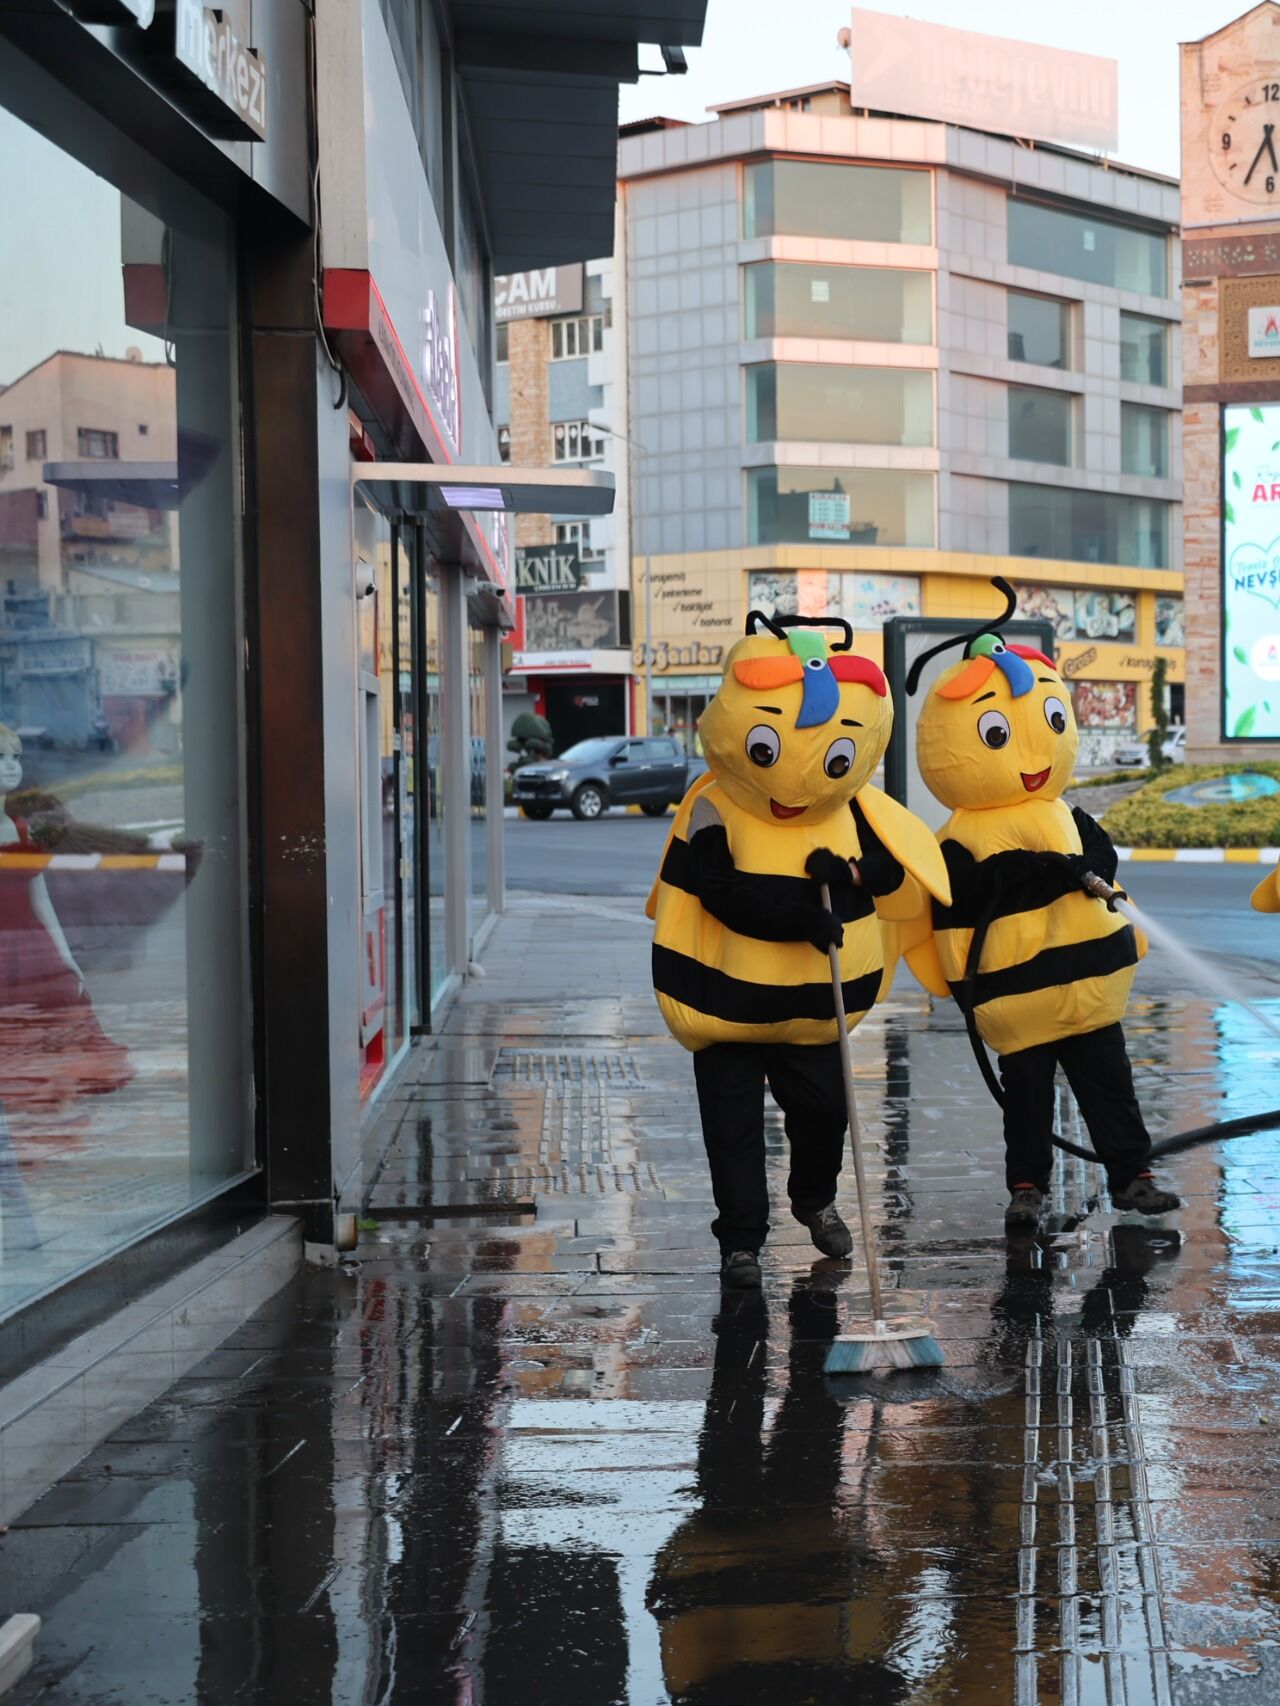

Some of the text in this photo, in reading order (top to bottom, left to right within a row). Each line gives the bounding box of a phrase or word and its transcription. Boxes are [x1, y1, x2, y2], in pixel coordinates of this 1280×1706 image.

[180, 3, 266, 129] merkezi
[1262, 84, 1280, 102] 12
[1221, 133, 1232, 150] 9
[1265, 176, 1275, 193] 6
[516, 549, 577, 588] KNİK
[1062, 645, 1098, 679] Gross
